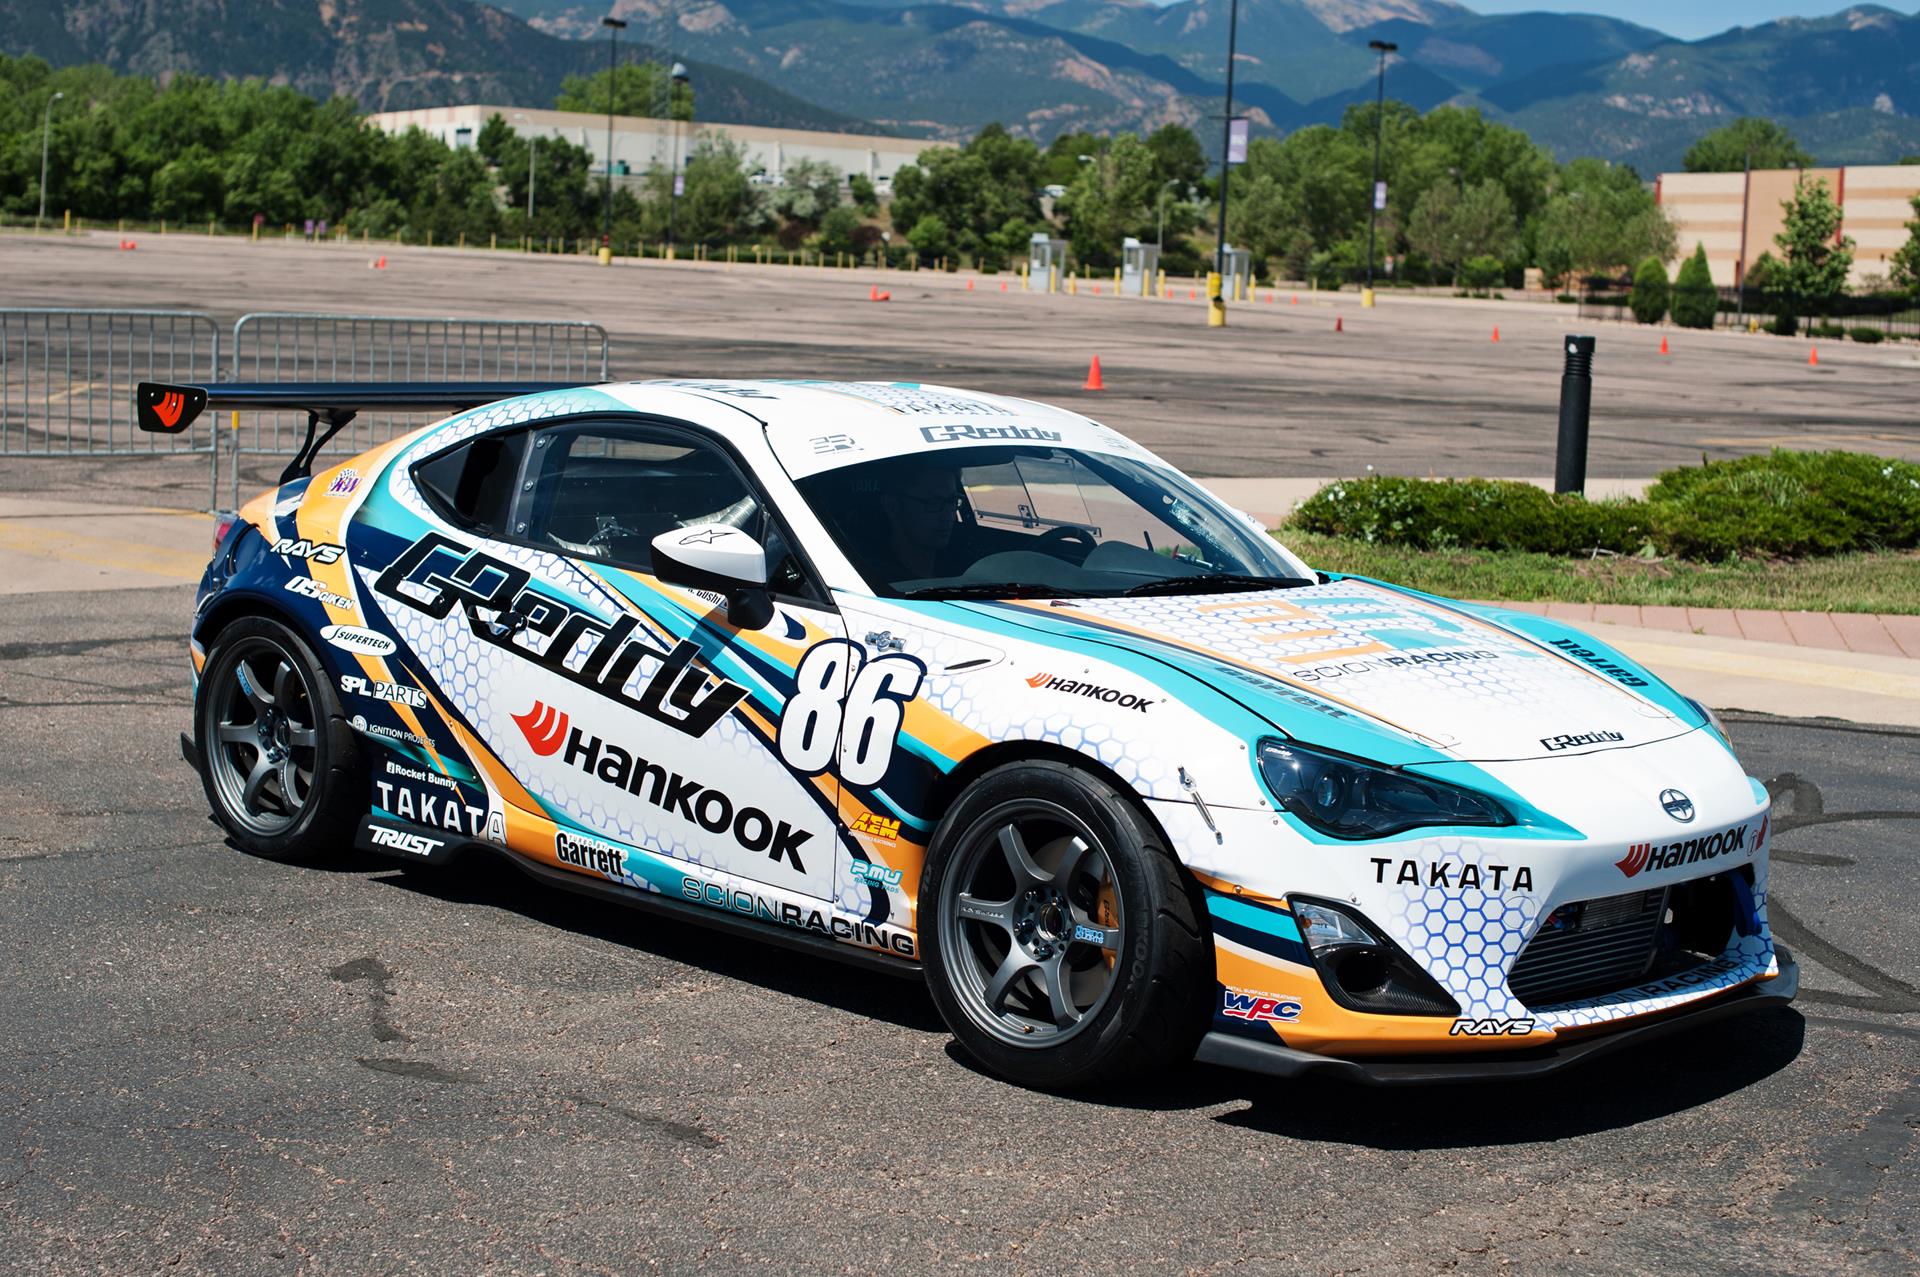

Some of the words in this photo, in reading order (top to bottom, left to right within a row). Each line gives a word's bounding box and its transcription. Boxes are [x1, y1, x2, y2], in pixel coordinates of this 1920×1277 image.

[919, 424, 1062, 443] GReddy
[270, 538, 345, 565] RAYS
[284, 575, 327, 600] OS
[317, 588, 354, 611] GIKEN
[334, 629, 392, 651] SUPERTECH
[340, 674, 373, 697] SPL
[373, 680, 427, 709] PARTS
[778, 639, 927, 786] 86
[369, 724, 403, 740] IGNITION
[403, 731, 436, 748] PROJECTS
[395, 764, 426, 781] Rocket
[427, 772, 458, 791] Bunny
[376, 779, 508, 847] TAKATA
[851, 811, 902, 841] AEM
[367, 824, 445, 856] TRUST
[556, 832, 625, 877] Garrett
[1370, 857, 1534, 893] TAKATA
[682, 876, 916, 956] SCIONRACING
[1449, 1018, 1536, 1037] RAYS
